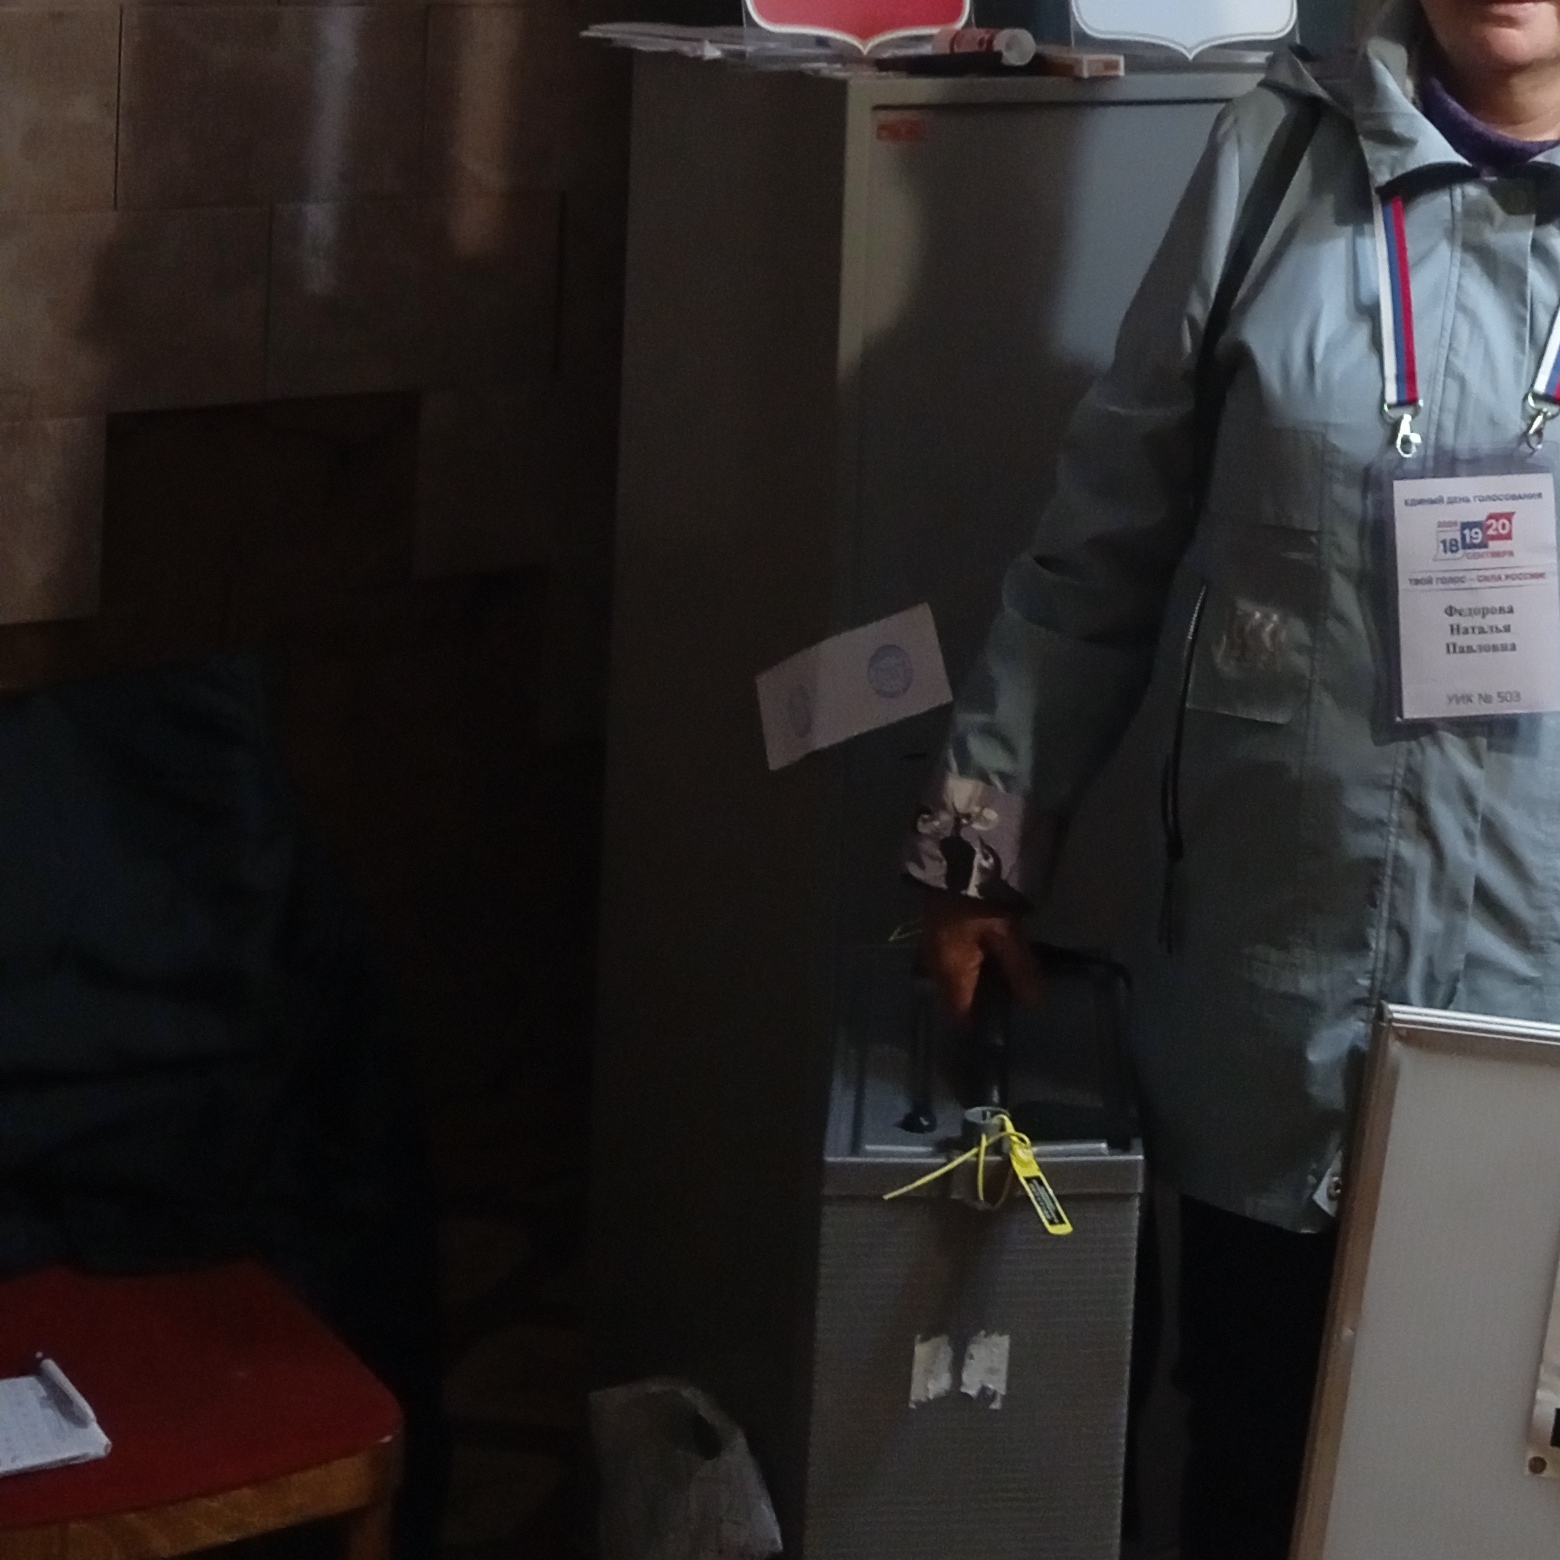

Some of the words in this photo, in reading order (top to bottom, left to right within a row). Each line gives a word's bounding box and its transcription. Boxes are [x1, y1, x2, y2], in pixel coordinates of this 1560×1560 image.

[1446, 495, 1471, 505] ДЕНЬ
[1473, 491, 1543, 503] ГОЛОСОВАНИЯ
[1485, 518, 1511, 535] 20
[1462, 527, 1483, 545] 19
[1439, 537, 1460, 555] 18
[1443, 603, 1515, 621] Федорова
[1449, 621, 1512, 637] Наталья
[1445, 640, 1517, 656] Павловна
[1446, 692, 1474, 706] УИК
[1477, 692, 1493, 705] №
[1496, 689, 1522, 704] 503
